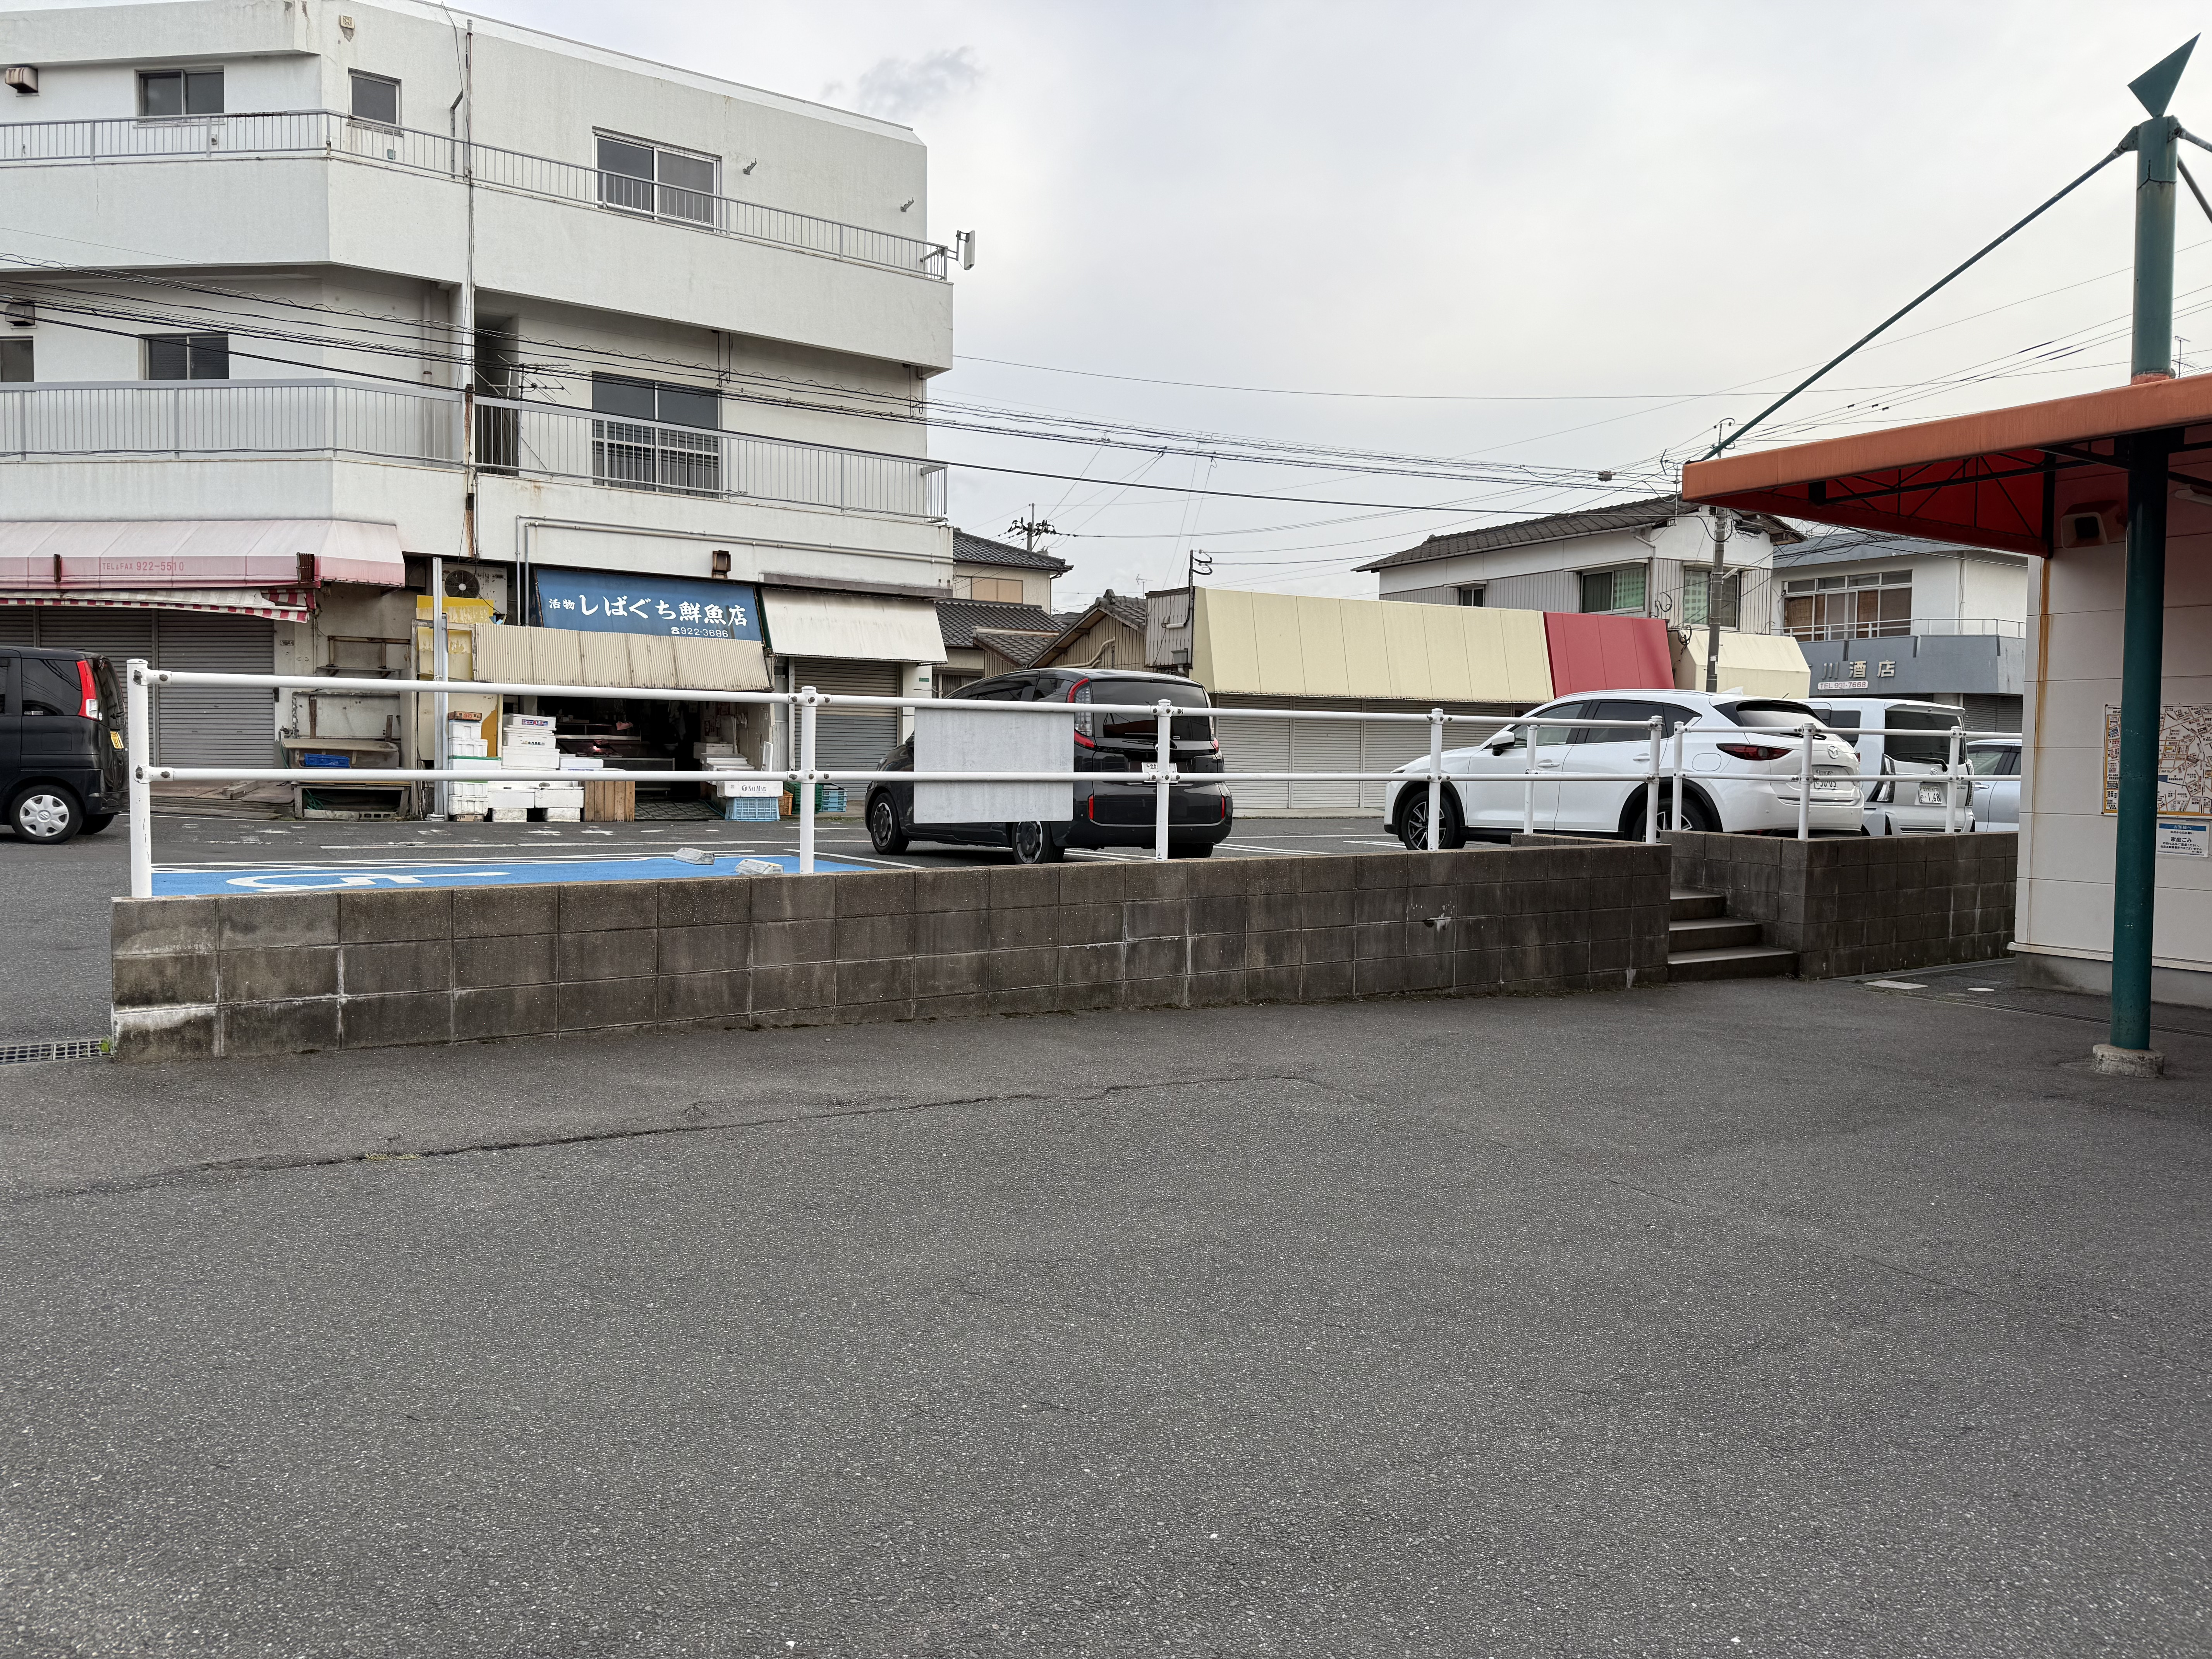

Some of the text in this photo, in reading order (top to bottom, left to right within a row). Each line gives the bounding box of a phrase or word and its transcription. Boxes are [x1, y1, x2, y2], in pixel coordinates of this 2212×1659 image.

[137, 562, 184, 570] 922-5510
[549, 594, 747, 626] 活物 しばぐち鮮魚店
[681, 627, 729, 638] 922-3696
[1808, 660, 1895, 680] 川酒店
